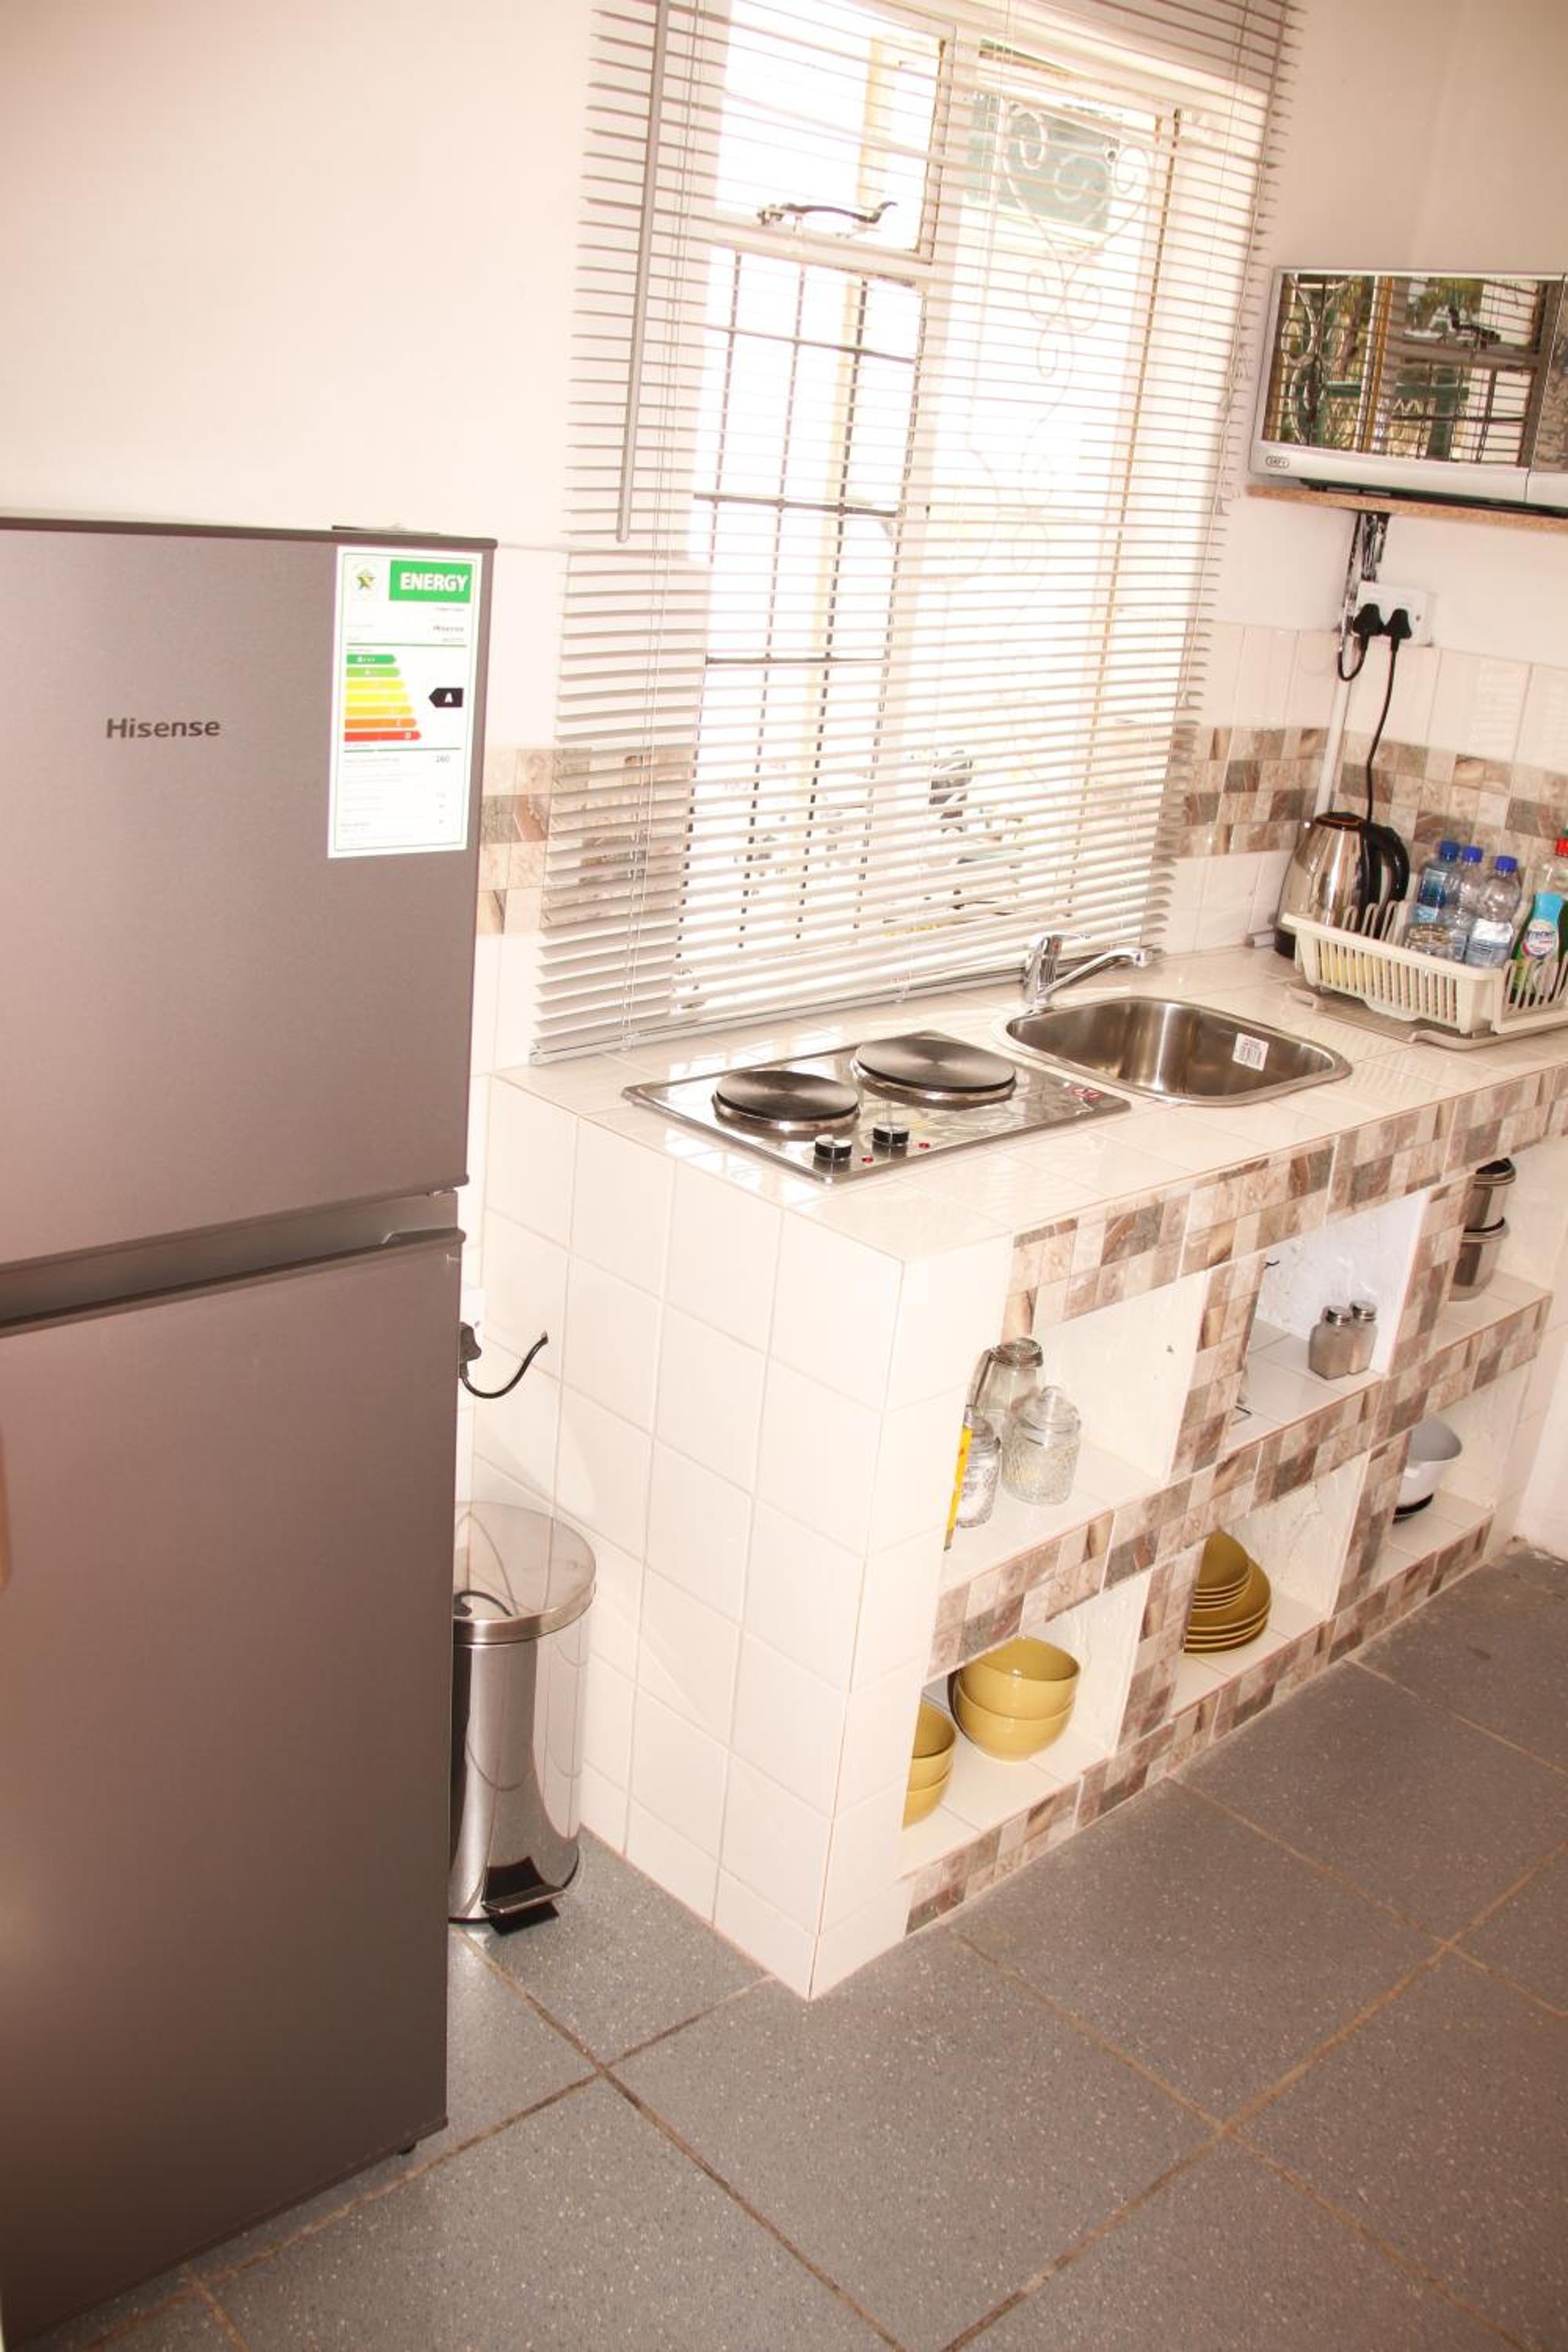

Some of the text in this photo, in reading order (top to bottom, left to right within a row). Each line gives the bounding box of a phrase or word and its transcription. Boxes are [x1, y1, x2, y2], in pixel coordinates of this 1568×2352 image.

[401, 572, 469, 592] ENERGY
[444, 691, 453, 703] A
[106, 717, 221, 739] Hisense
